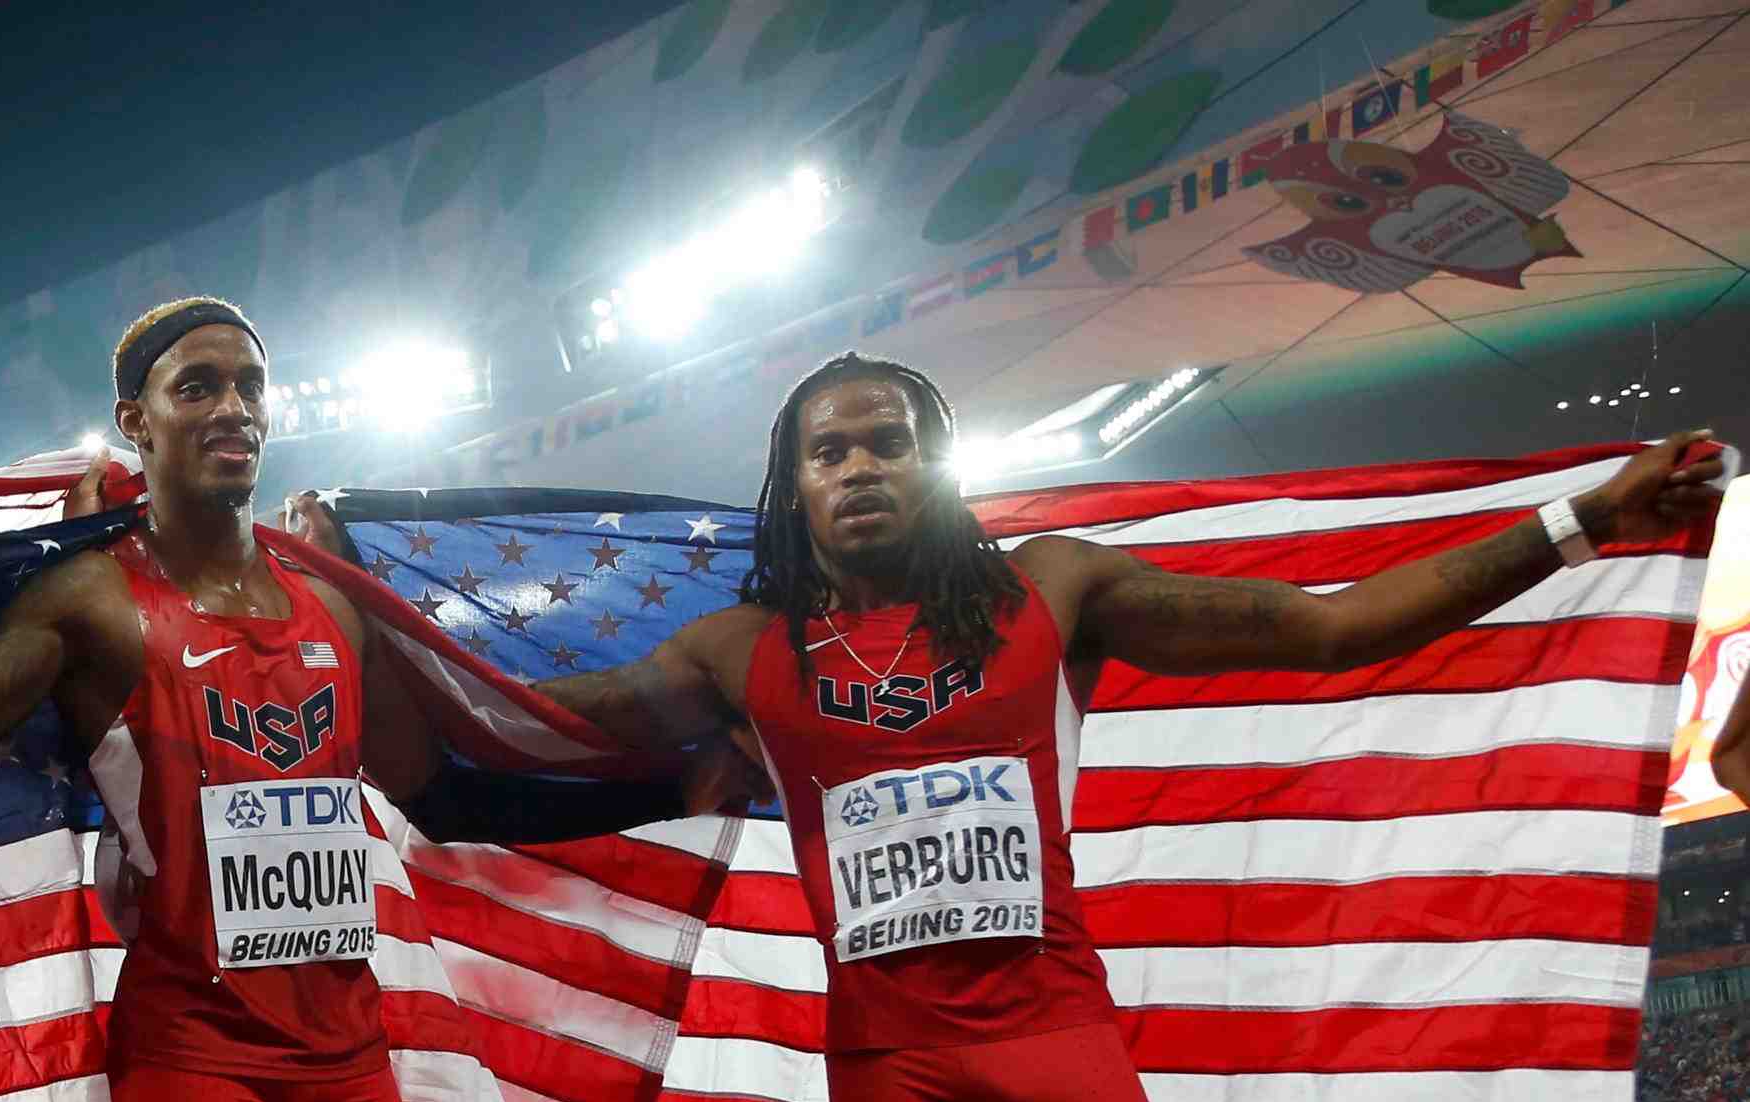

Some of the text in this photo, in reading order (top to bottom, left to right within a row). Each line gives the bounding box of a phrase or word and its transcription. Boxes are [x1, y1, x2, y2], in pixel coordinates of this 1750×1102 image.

[816, 660, 984, 733] USA
[203, 682, 336, 773] USA
[263, 785, 357, 826] TDK
[875, 763, 1017, 816] TDK
[220, 849, 367, 912] McQUAY
[836, 826, 1029, 910] VERBURG
[228, 926, 374, 963] BEIJING 2015
[847, 904, 1038, 954] BEIJING 2015
